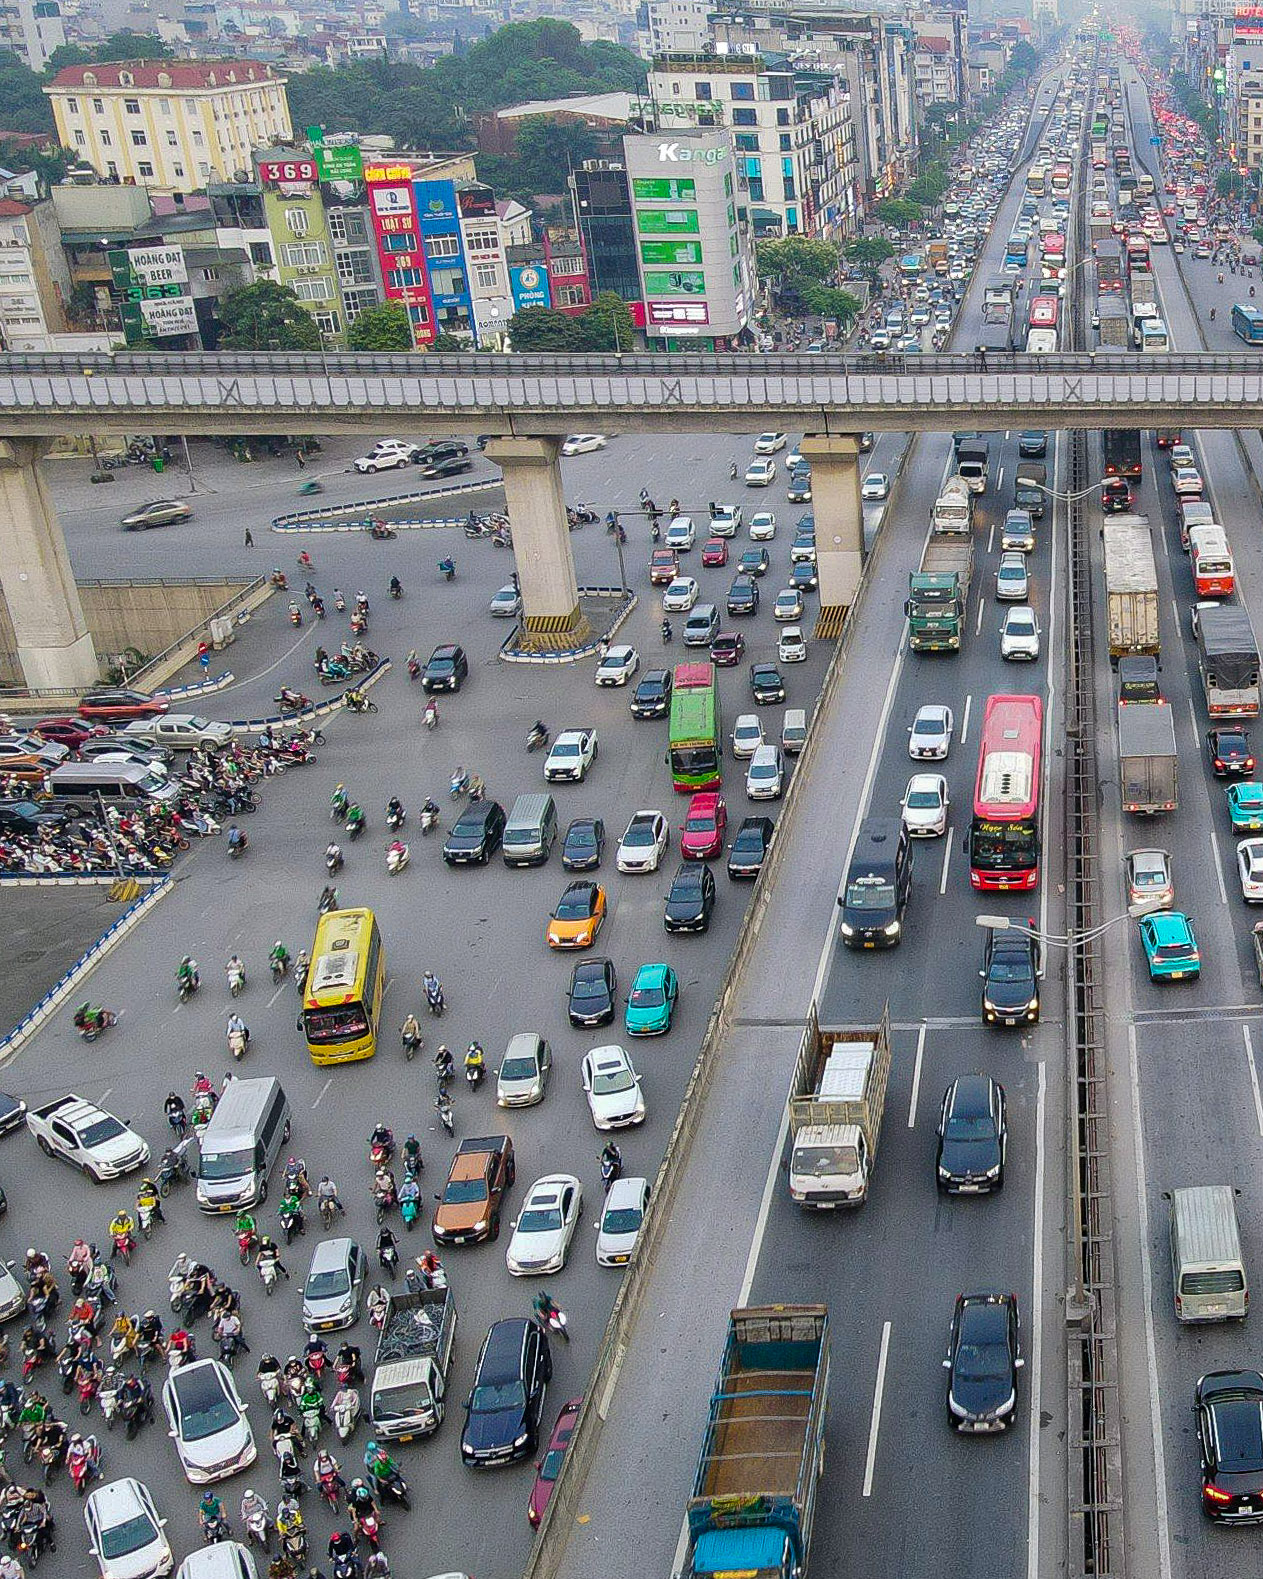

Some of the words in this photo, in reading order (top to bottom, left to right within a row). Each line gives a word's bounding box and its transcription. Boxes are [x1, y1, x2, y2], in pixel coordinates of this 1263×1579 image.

[268, 164, 312, 179] 369
[134, 253, 164, 266] HOÀNG
[165, 252, 181, 265] ĐẠT
[150, 269, 173, 280] BEER
[519, 290, 545, 300] PHÒNG
[149, 308, 177, 319] HOÀNG
